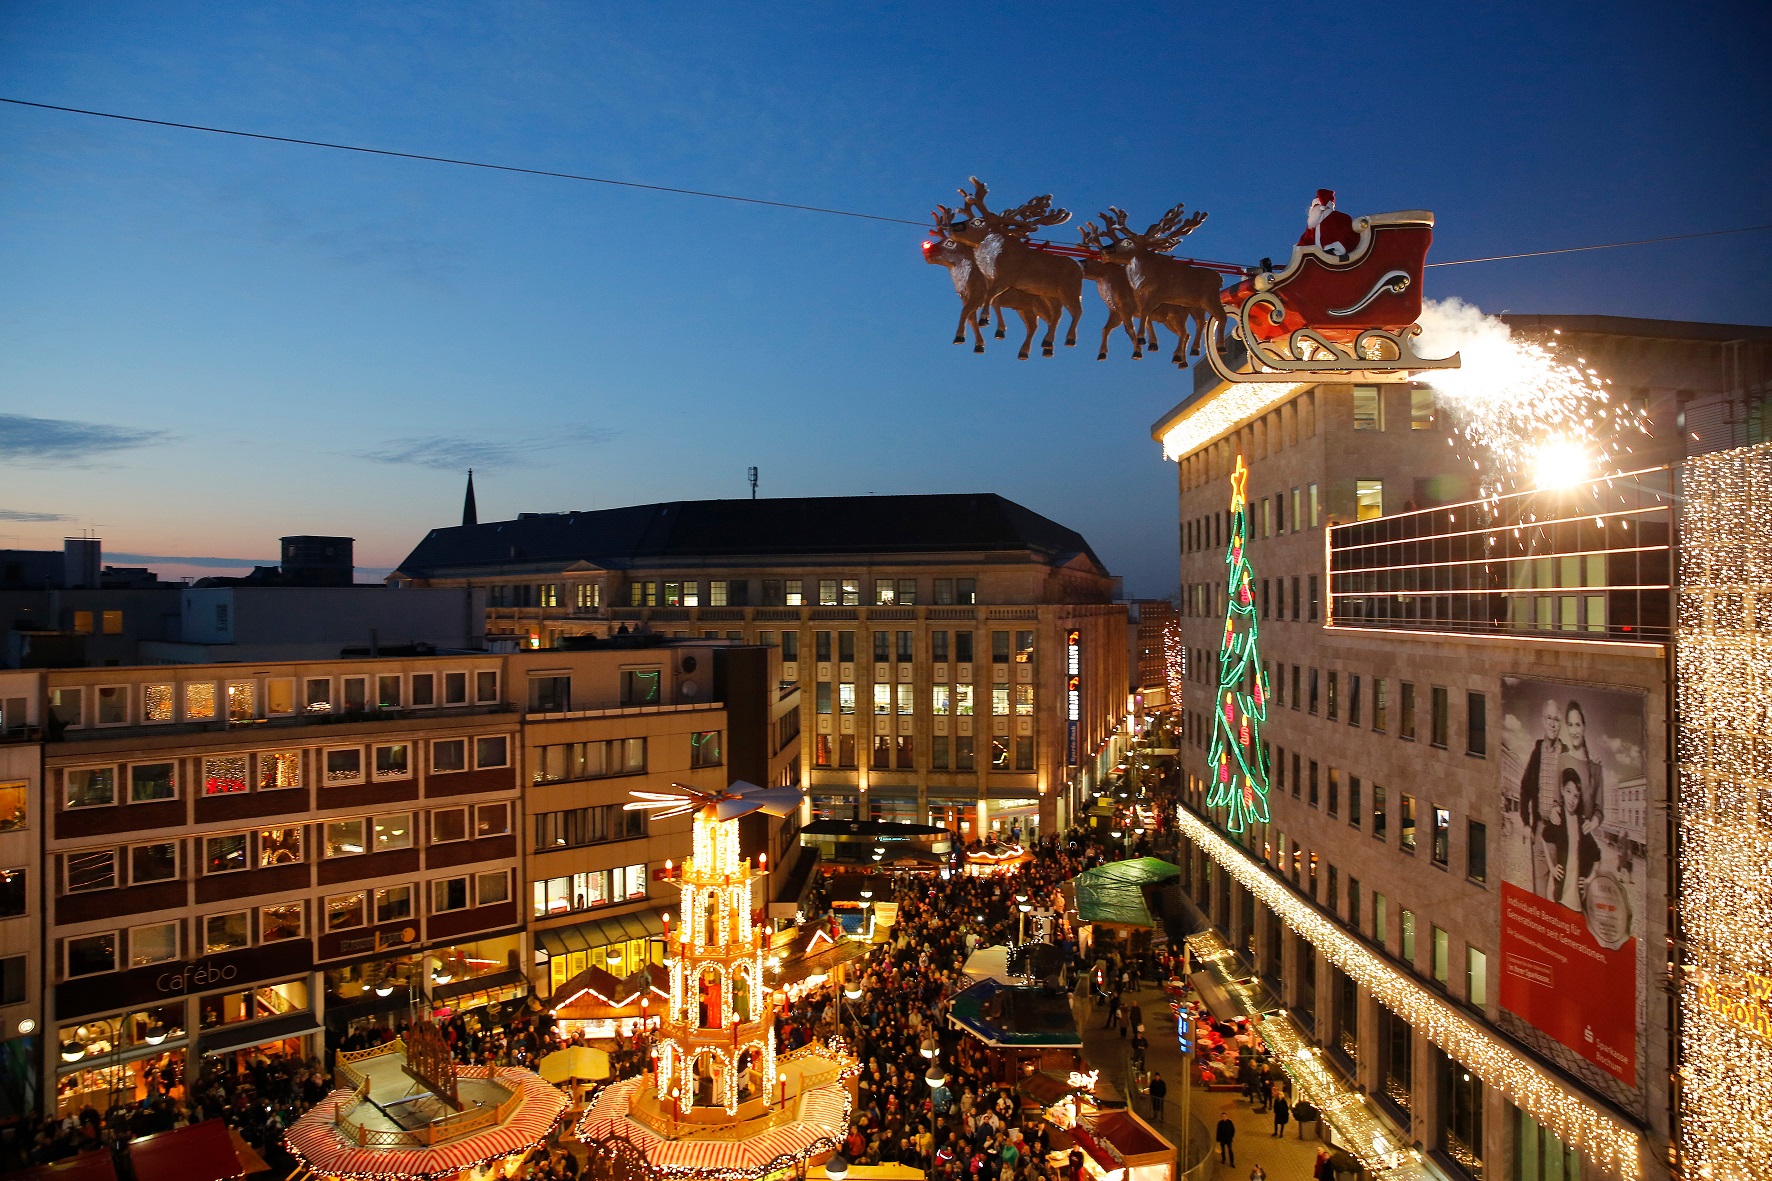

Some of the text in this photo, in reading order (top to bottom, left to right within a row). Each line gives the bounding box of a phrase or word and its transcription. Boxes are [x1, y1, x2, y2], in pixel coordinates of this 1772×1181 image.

[1506, 895, 1582, 936] Individuelle Beratung für
[1506, 908, 1546, 934] Generationen
[1546, 928, 1560, 941] seit
[1558, 933, 1608, 964] Generationen.
[156, 961, 238, 994] Cafébo
[1595, 1038, 1629, 1065] Sparkasse
[1595, 1051, 1623, 1074] Bochum
